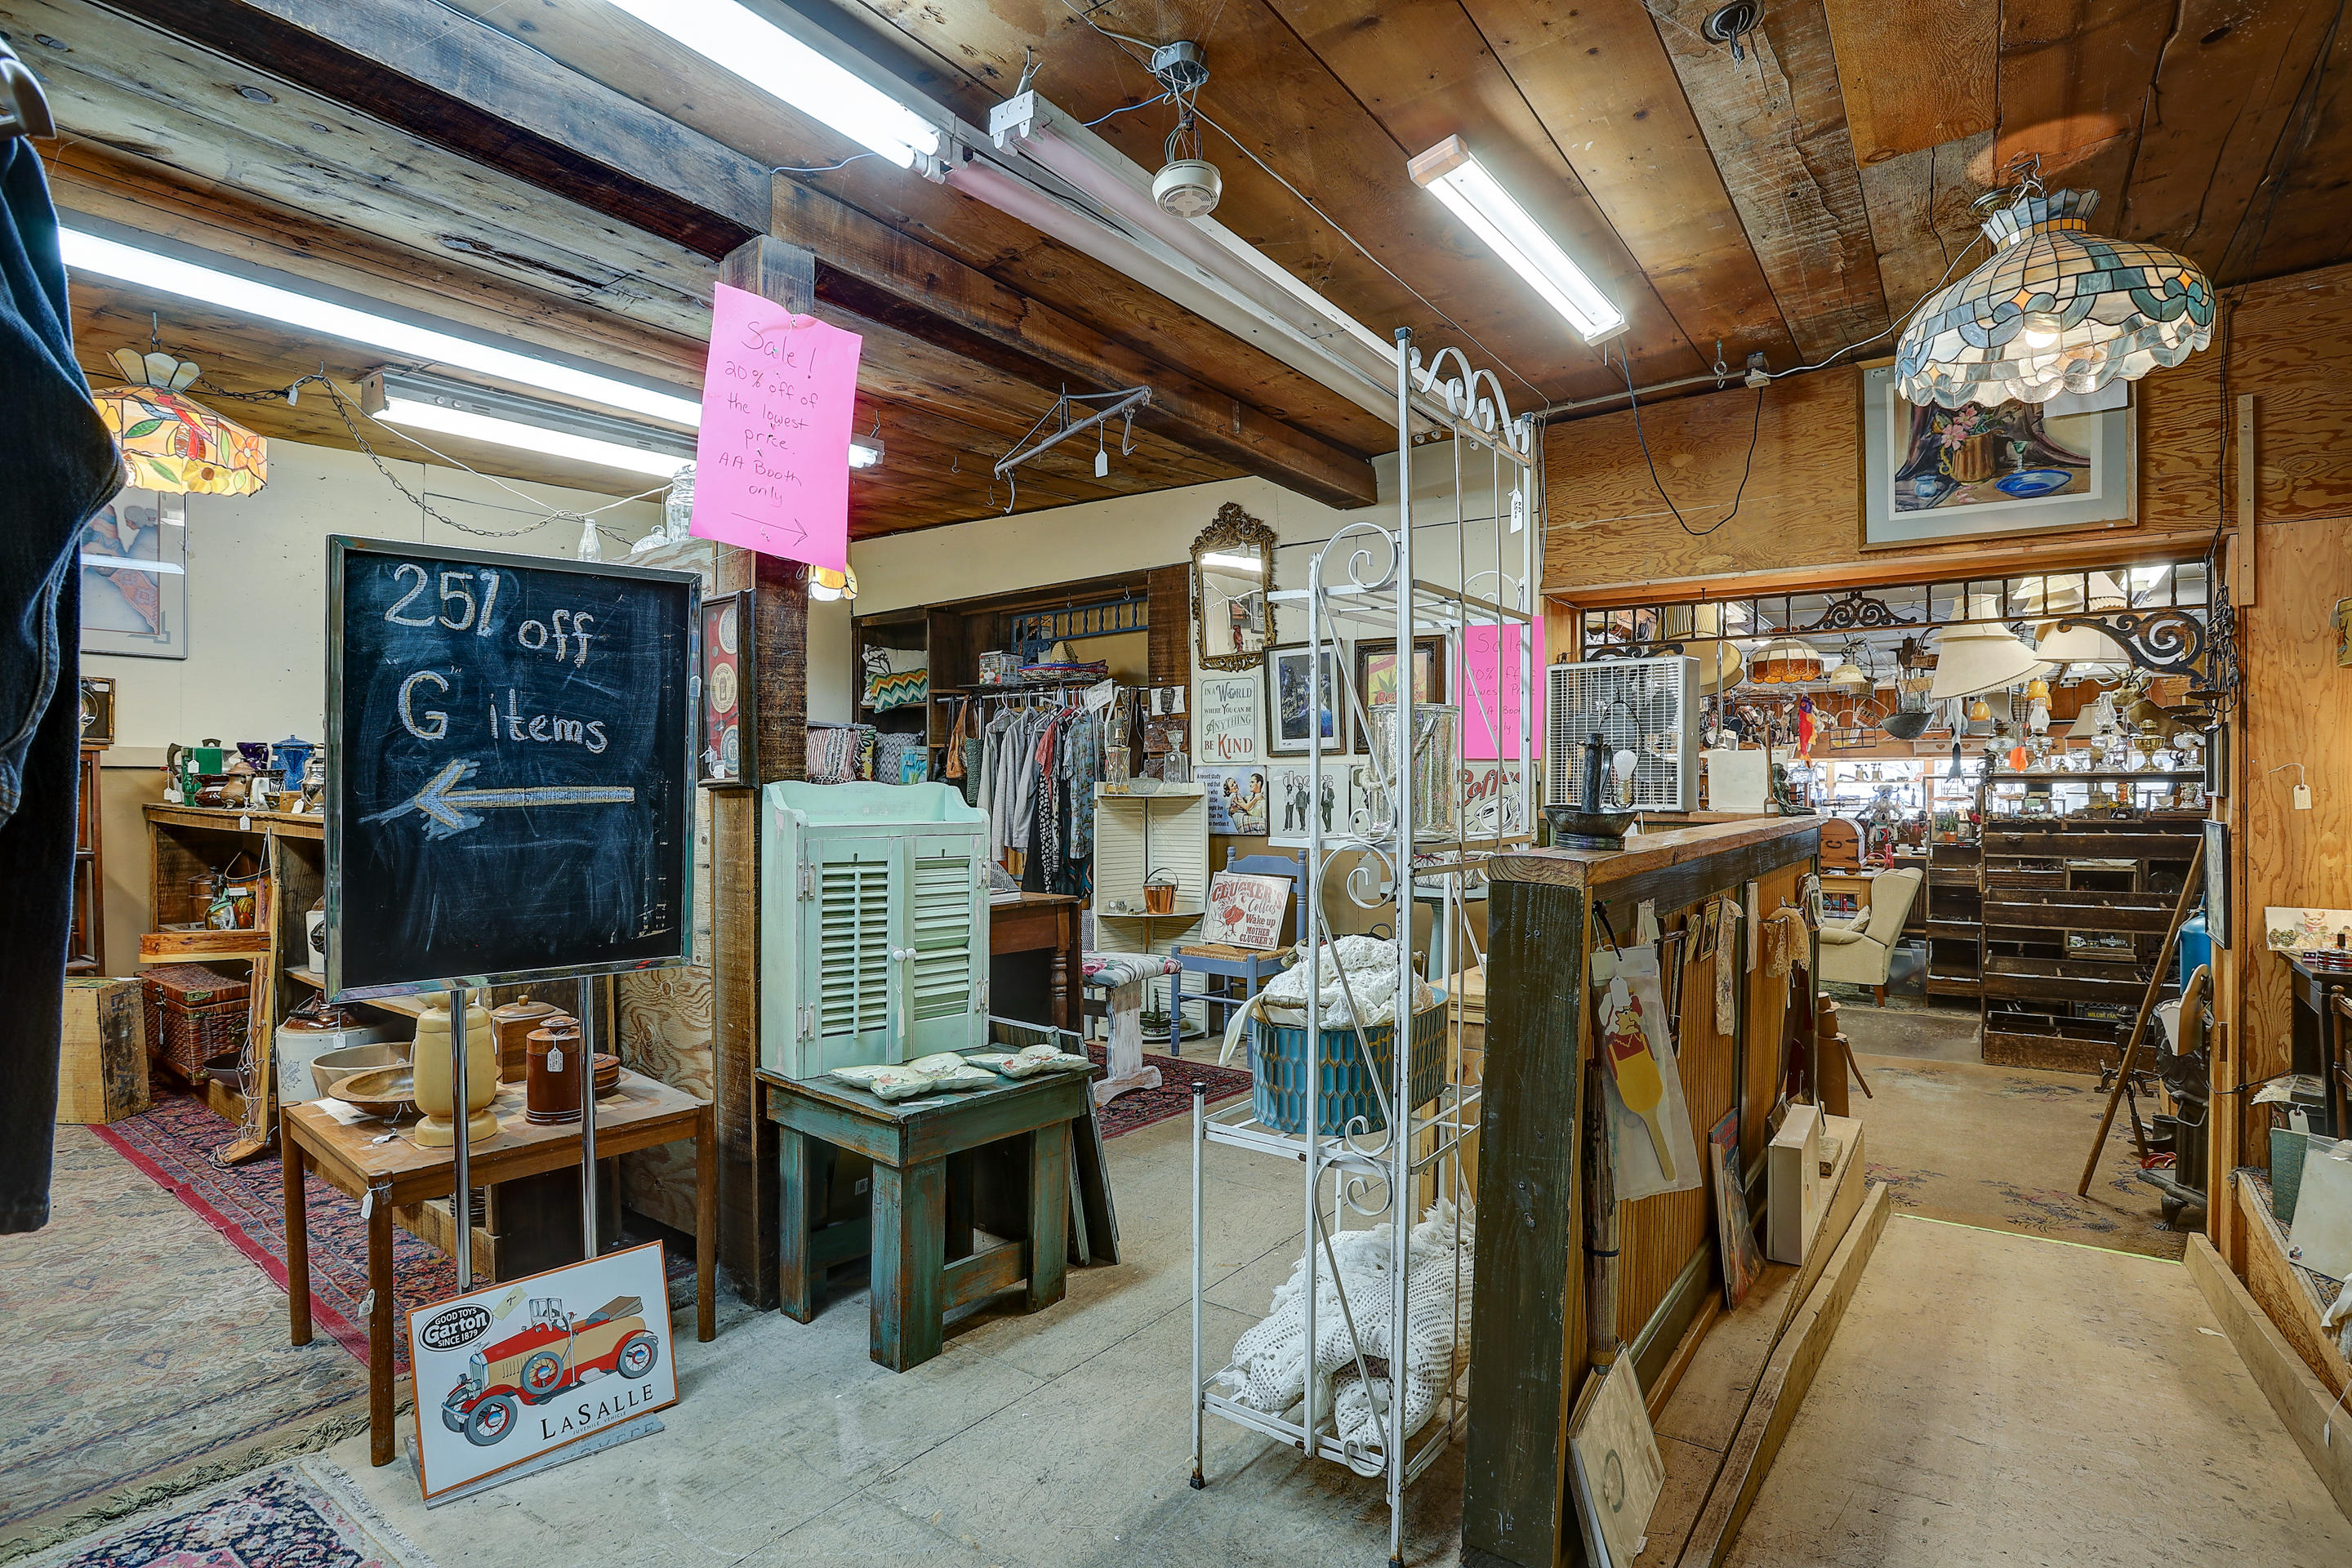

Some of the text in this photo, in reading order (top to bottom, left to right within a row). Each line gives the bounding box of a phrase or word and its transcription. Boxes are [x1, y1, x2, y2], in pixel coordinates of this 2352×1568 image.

[724, 361, 818, 409] 20% off of
[728, 392, 809, 430] the lowest
[744, 428, 790, 451] price
[719, 452, 802, 487] AA Booth
[748, 484, 783, 508] only
[518, 609, 597, 667] off
[1216, 681, 1252, 702] WORLD
[1468, 688, 1498, 697] Lwes
[398, 670, 608, 753] G items
[1222, 703, 1233, 715] YOU
[1503, 706, 1520, 715] Boo
[1205, 715, 1251, 736] ANYTHING
[1494, 722, 1512, 734] oly
[1204, 733, 1253, 760] BE KIND
[1283, 771, 1334, 787] doos
[1212, 881, 1283, 910] CLUCKER'S
[1246, 914, 1276, 928] Wake up
[1246, 926, 1270, 937] MOTHER
[1240, 934, 1273, 945] CLUCKER'S
[434, 1307, 477, 1325] GOOD TOYS
[425, 1312, 488, 1343] Garton
[438, 1329, 478, 1347] SINCE 1879
[572, 1411, 626, 1435] JUVENILE VEHICLE
